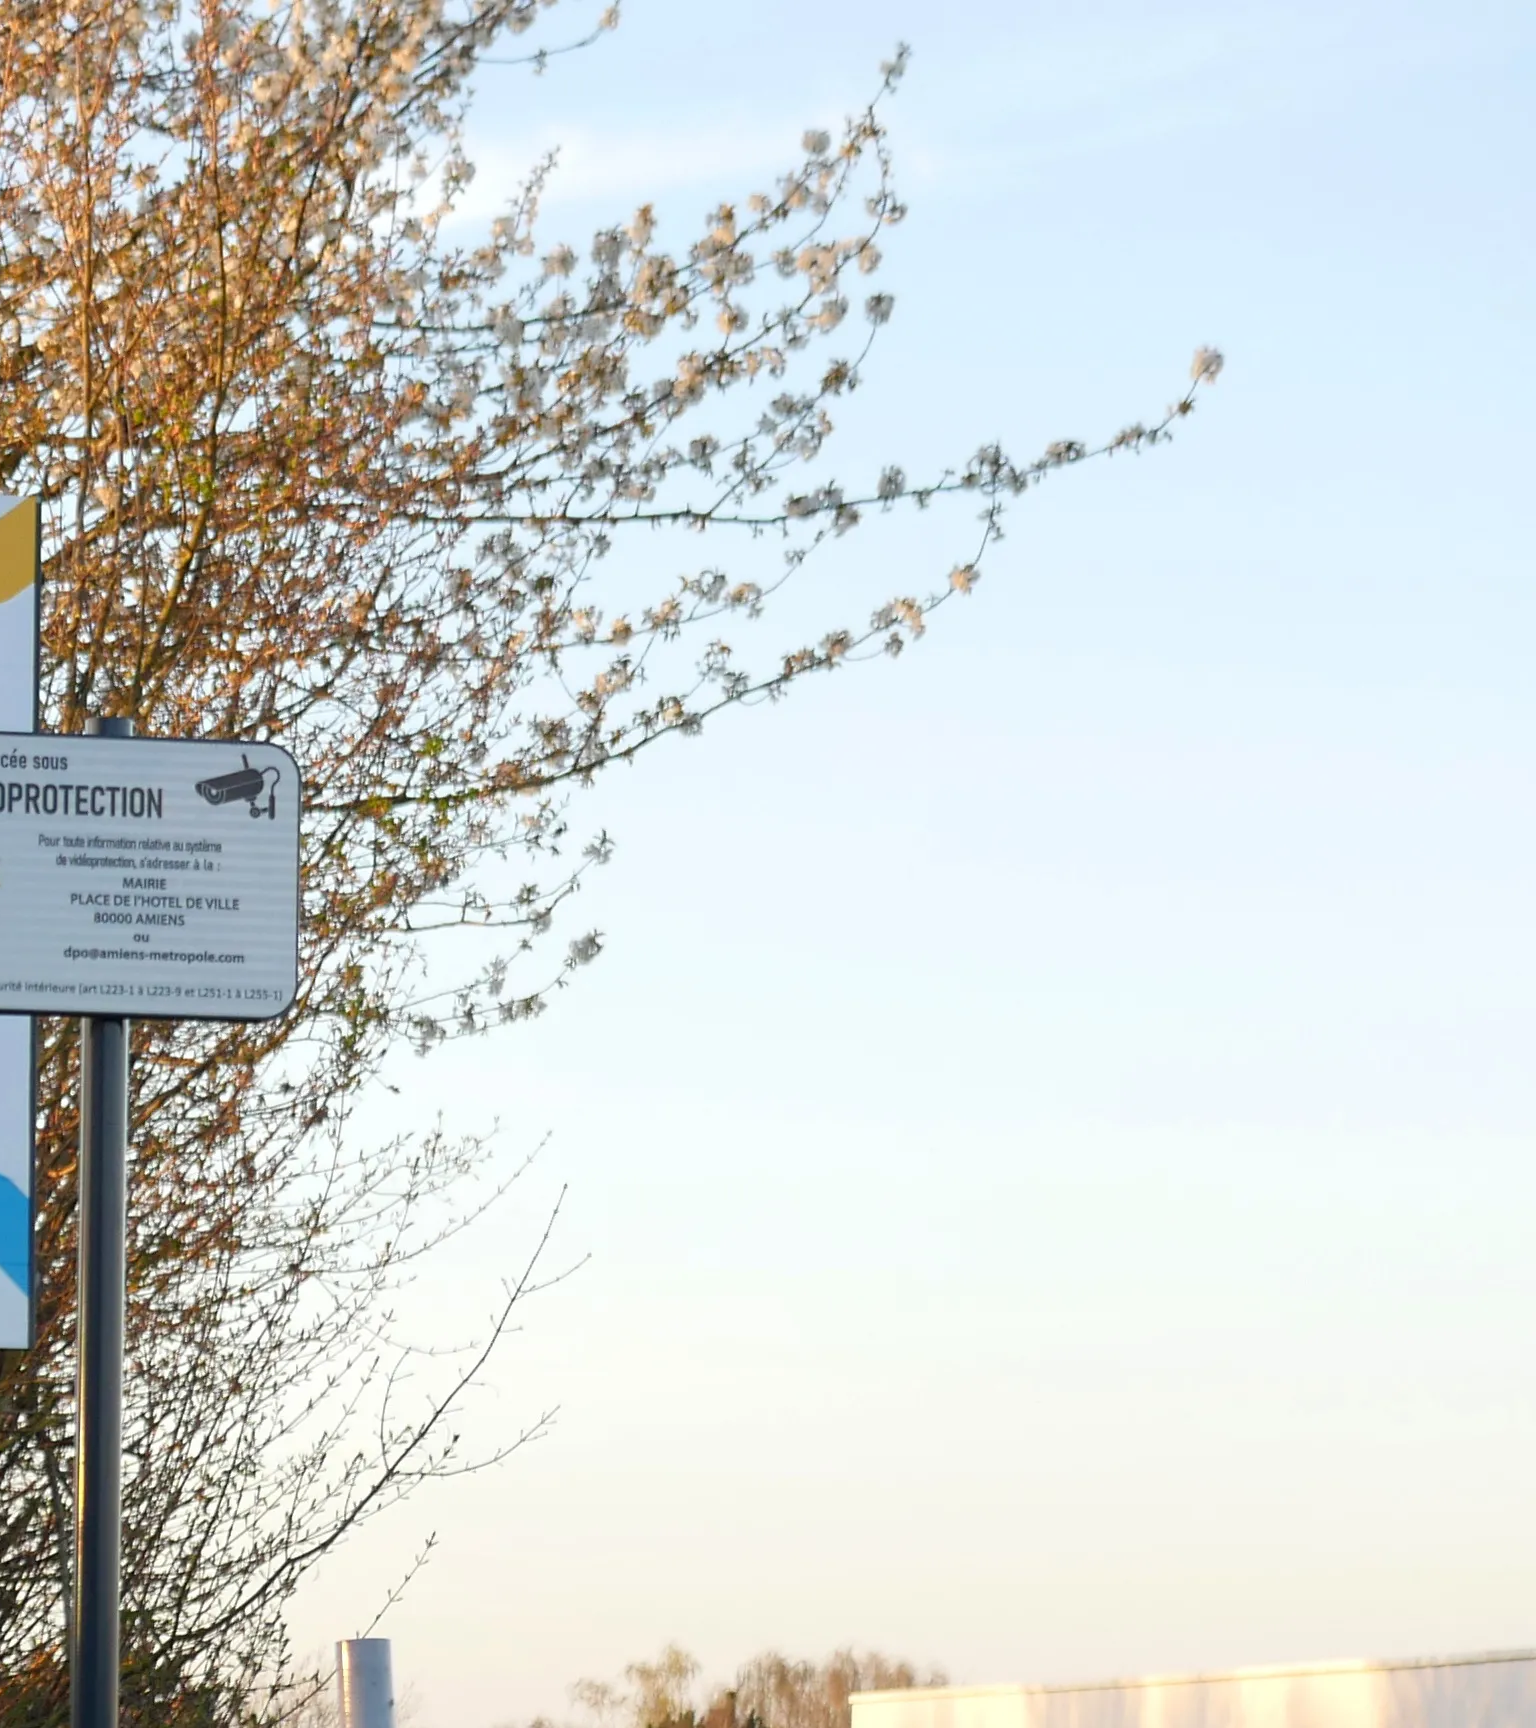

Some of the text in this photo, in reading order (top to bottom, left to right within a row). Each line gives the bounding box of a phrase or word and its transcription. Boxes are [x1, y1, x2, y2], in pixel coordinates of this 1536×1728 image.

[32, 755, 69, 771] sous
[38, 833, 222, 855] Pour toute information relative au système
[55, 853, 68, 866] de
[68, 852, 138, 870] vidéoprotection,
[139, 856, 191, 871] s'adresser
[203, 858, 214, 872] la
[122, 877, 167, 891] MAIRIE
[70, 892, 111, 906] PLACE
[113, 894, 131, 907] DE
[185, 896, 203, 910] DE
[204, 897, 240, 911] VILLE
[93, 911, 185, 927] 80000 AMIENS
[133, 933, 150, 943] ou
[63, 945, 245, 965] dpo@amiens-metropole.com
[24, 981, 76, 994] intérieure
[184, 988, 195, 998] et
